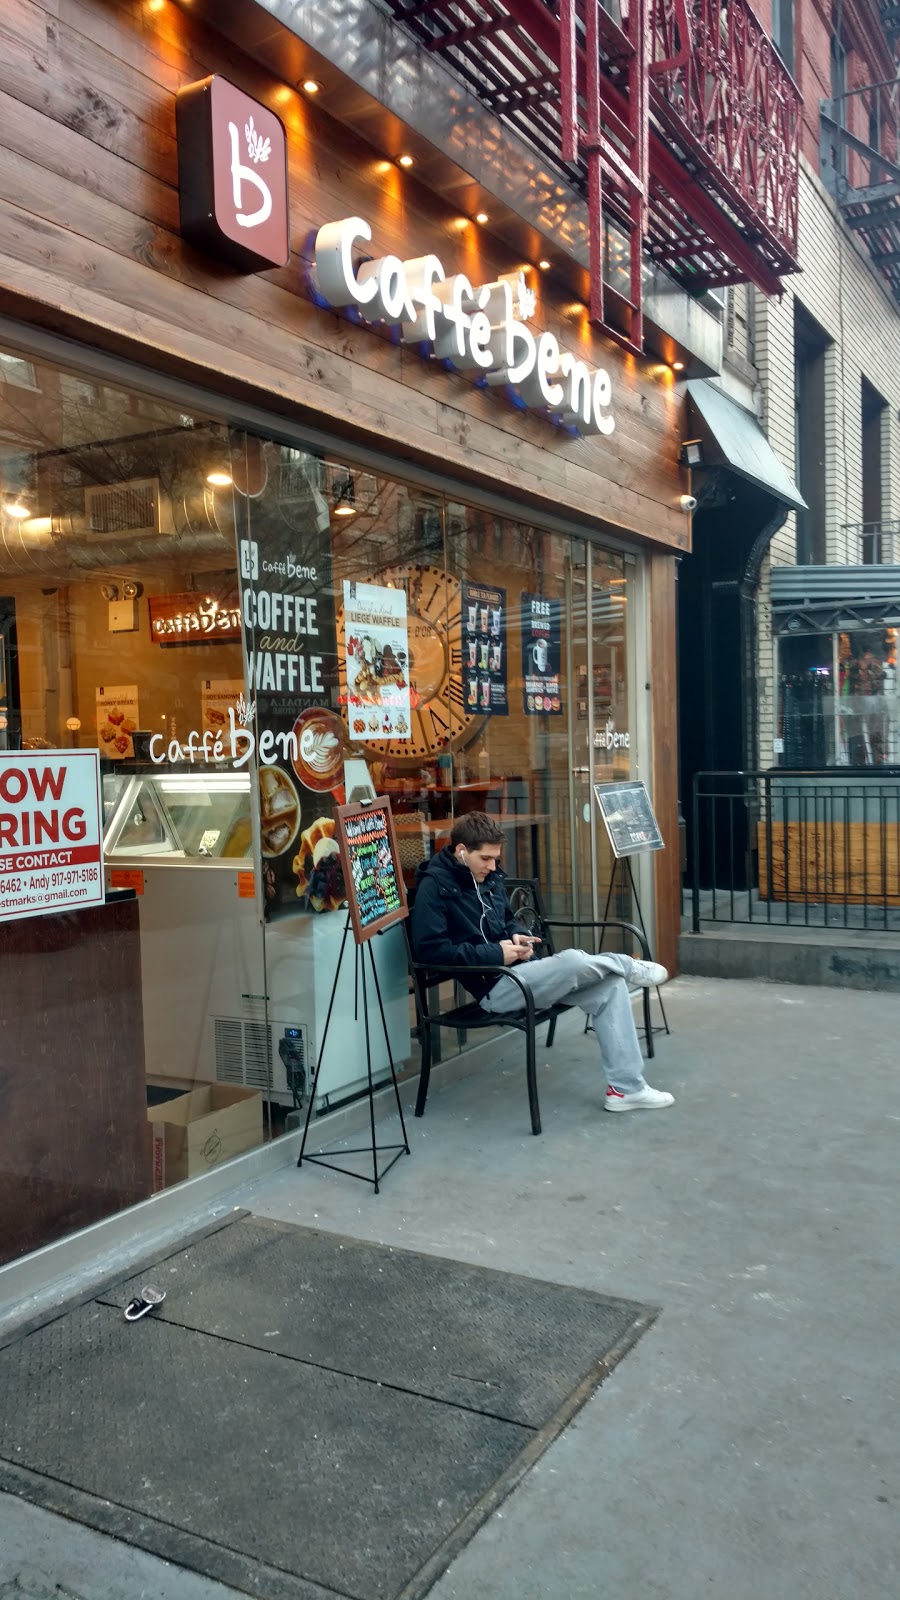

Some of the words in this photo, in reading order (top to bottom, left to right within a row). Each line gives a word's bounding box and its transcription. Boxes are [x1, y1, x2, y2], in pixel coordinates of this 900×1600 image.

[243, 588, 320, 636] COFFEE
[531, 600, 551, 616] FREE
[350, 612, 371, 624] LIEGE
[371, 615, 400, 627] WAFFLE
[259, 627, 305, 653] and
[246, 650, 325, 693] WAFFLE
[16, 850, 73, 869] CONTACT
[29, 873, 50, 890] Andy
[51, 867, 98, 887] 917-971-5186
[0, 888, 88, 908] stmarks@gmail.com
